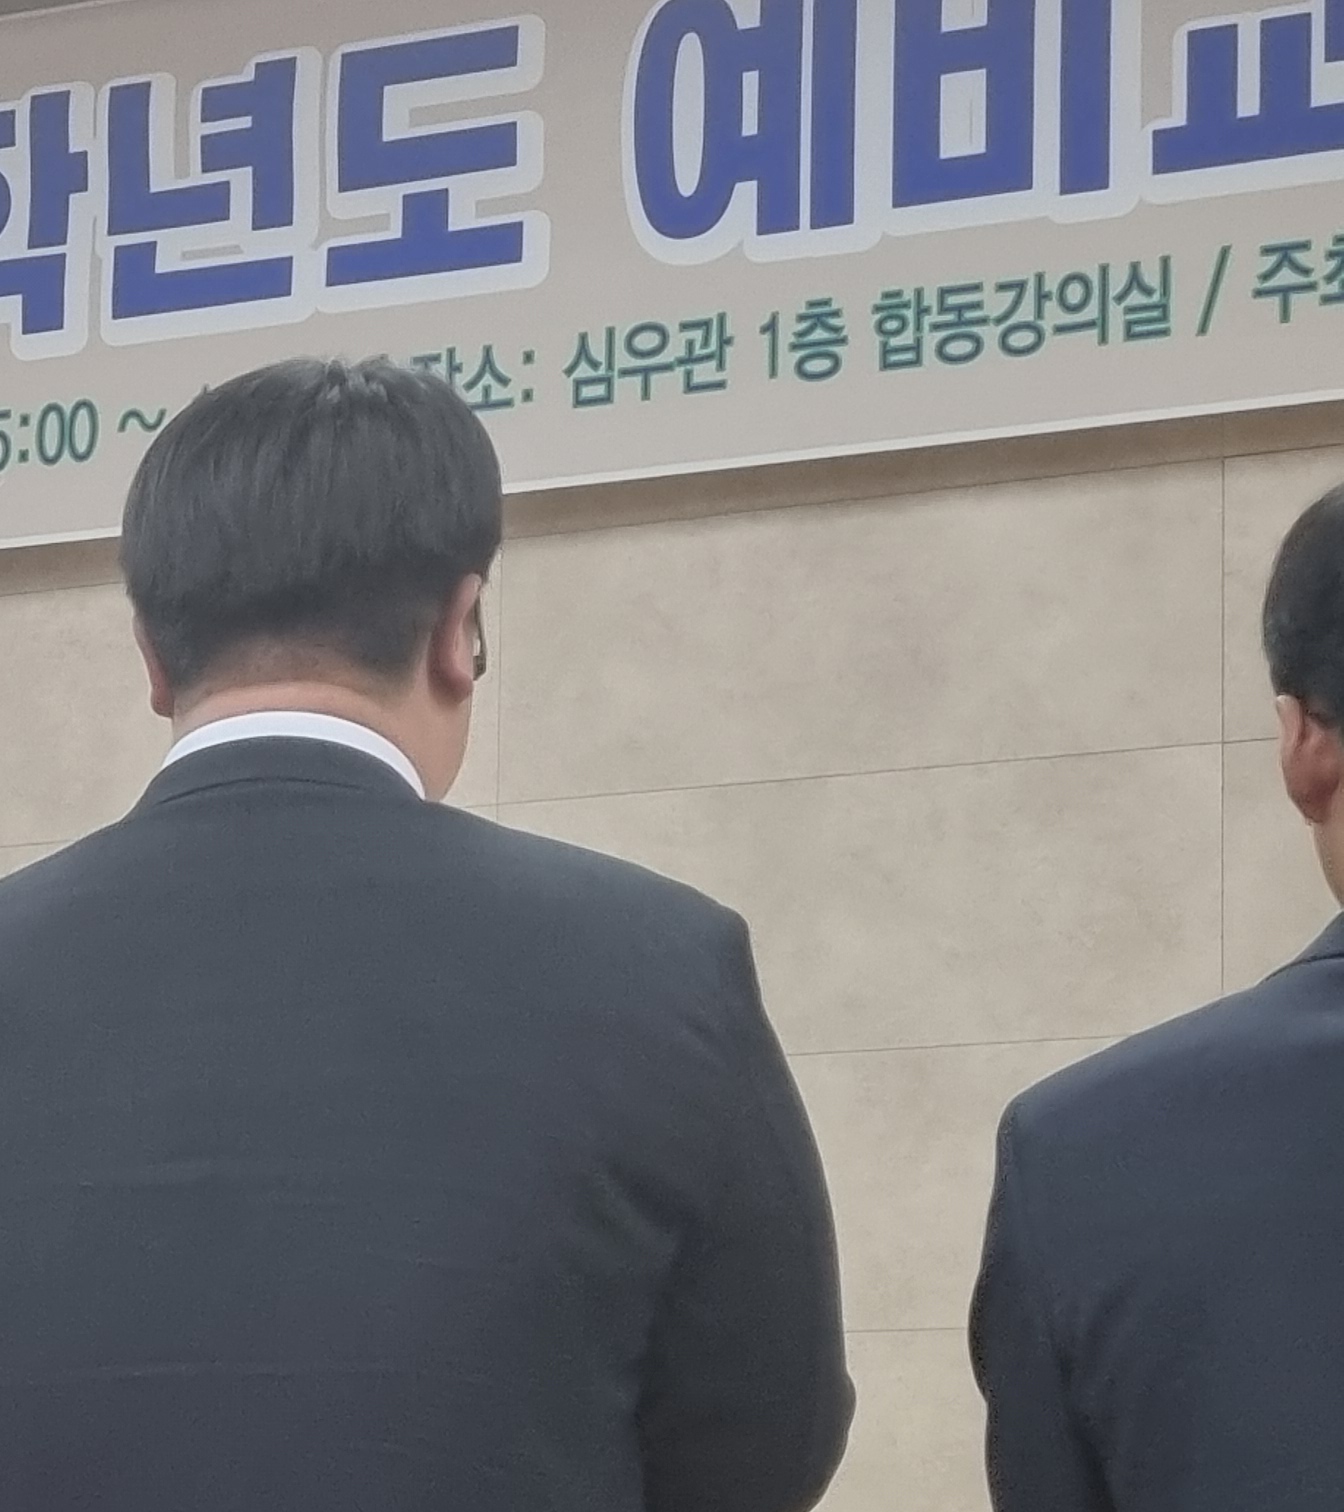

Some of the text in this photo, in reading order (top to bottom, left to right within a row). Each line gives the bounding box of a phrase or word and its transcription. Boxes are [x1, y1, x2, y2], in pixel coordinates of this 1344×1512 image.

[562, 311, 736, 409] 심우관
[759, 296, 850, 383] 1층
[870, 254, 1173, 372] 합동강의실
[1195, 245, 1232, 338] /
